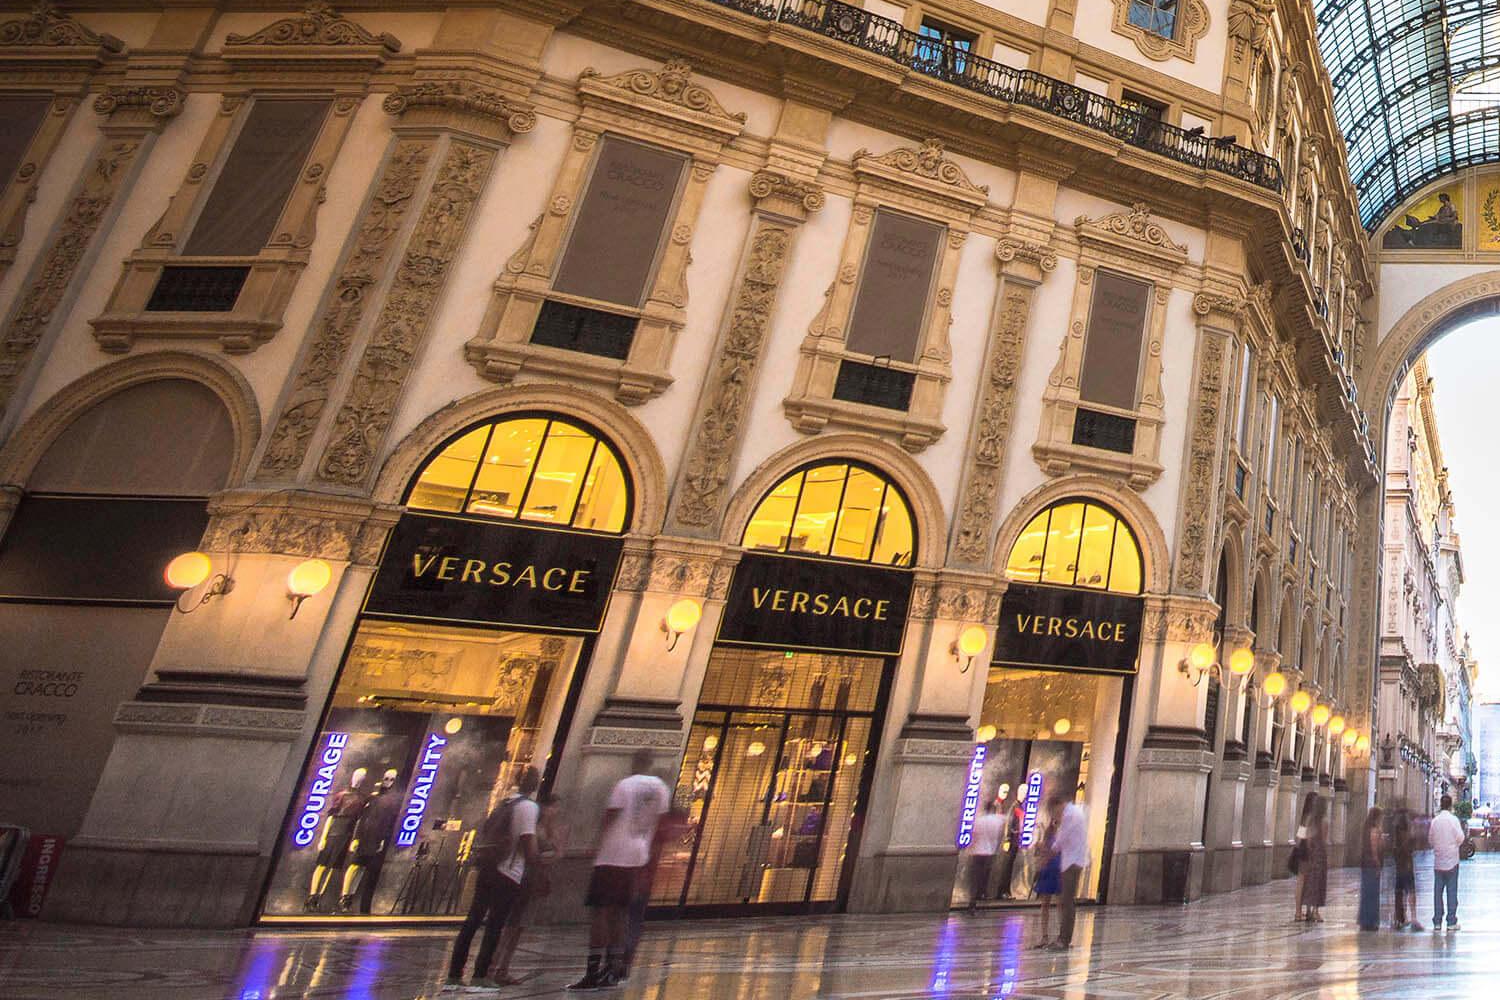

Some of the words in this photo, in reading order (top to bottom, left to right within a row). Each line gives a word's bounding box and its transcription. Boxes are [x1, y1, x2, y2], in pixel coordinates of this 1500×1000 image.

[412, 553, 592, 593] VERSACE
[752, 587, 890, 621] VERSACE
[1017, 613, 1126, 642] VERSACE
[15, 681, 78, 697] CRACCO
[294, 733, 348, 846] COURAGE
[397, 733, 447, 846] EQUALITY
[959, 746, 986, 845] STRENGTH
[1021, 772, 1042, 846] UNIFIED
